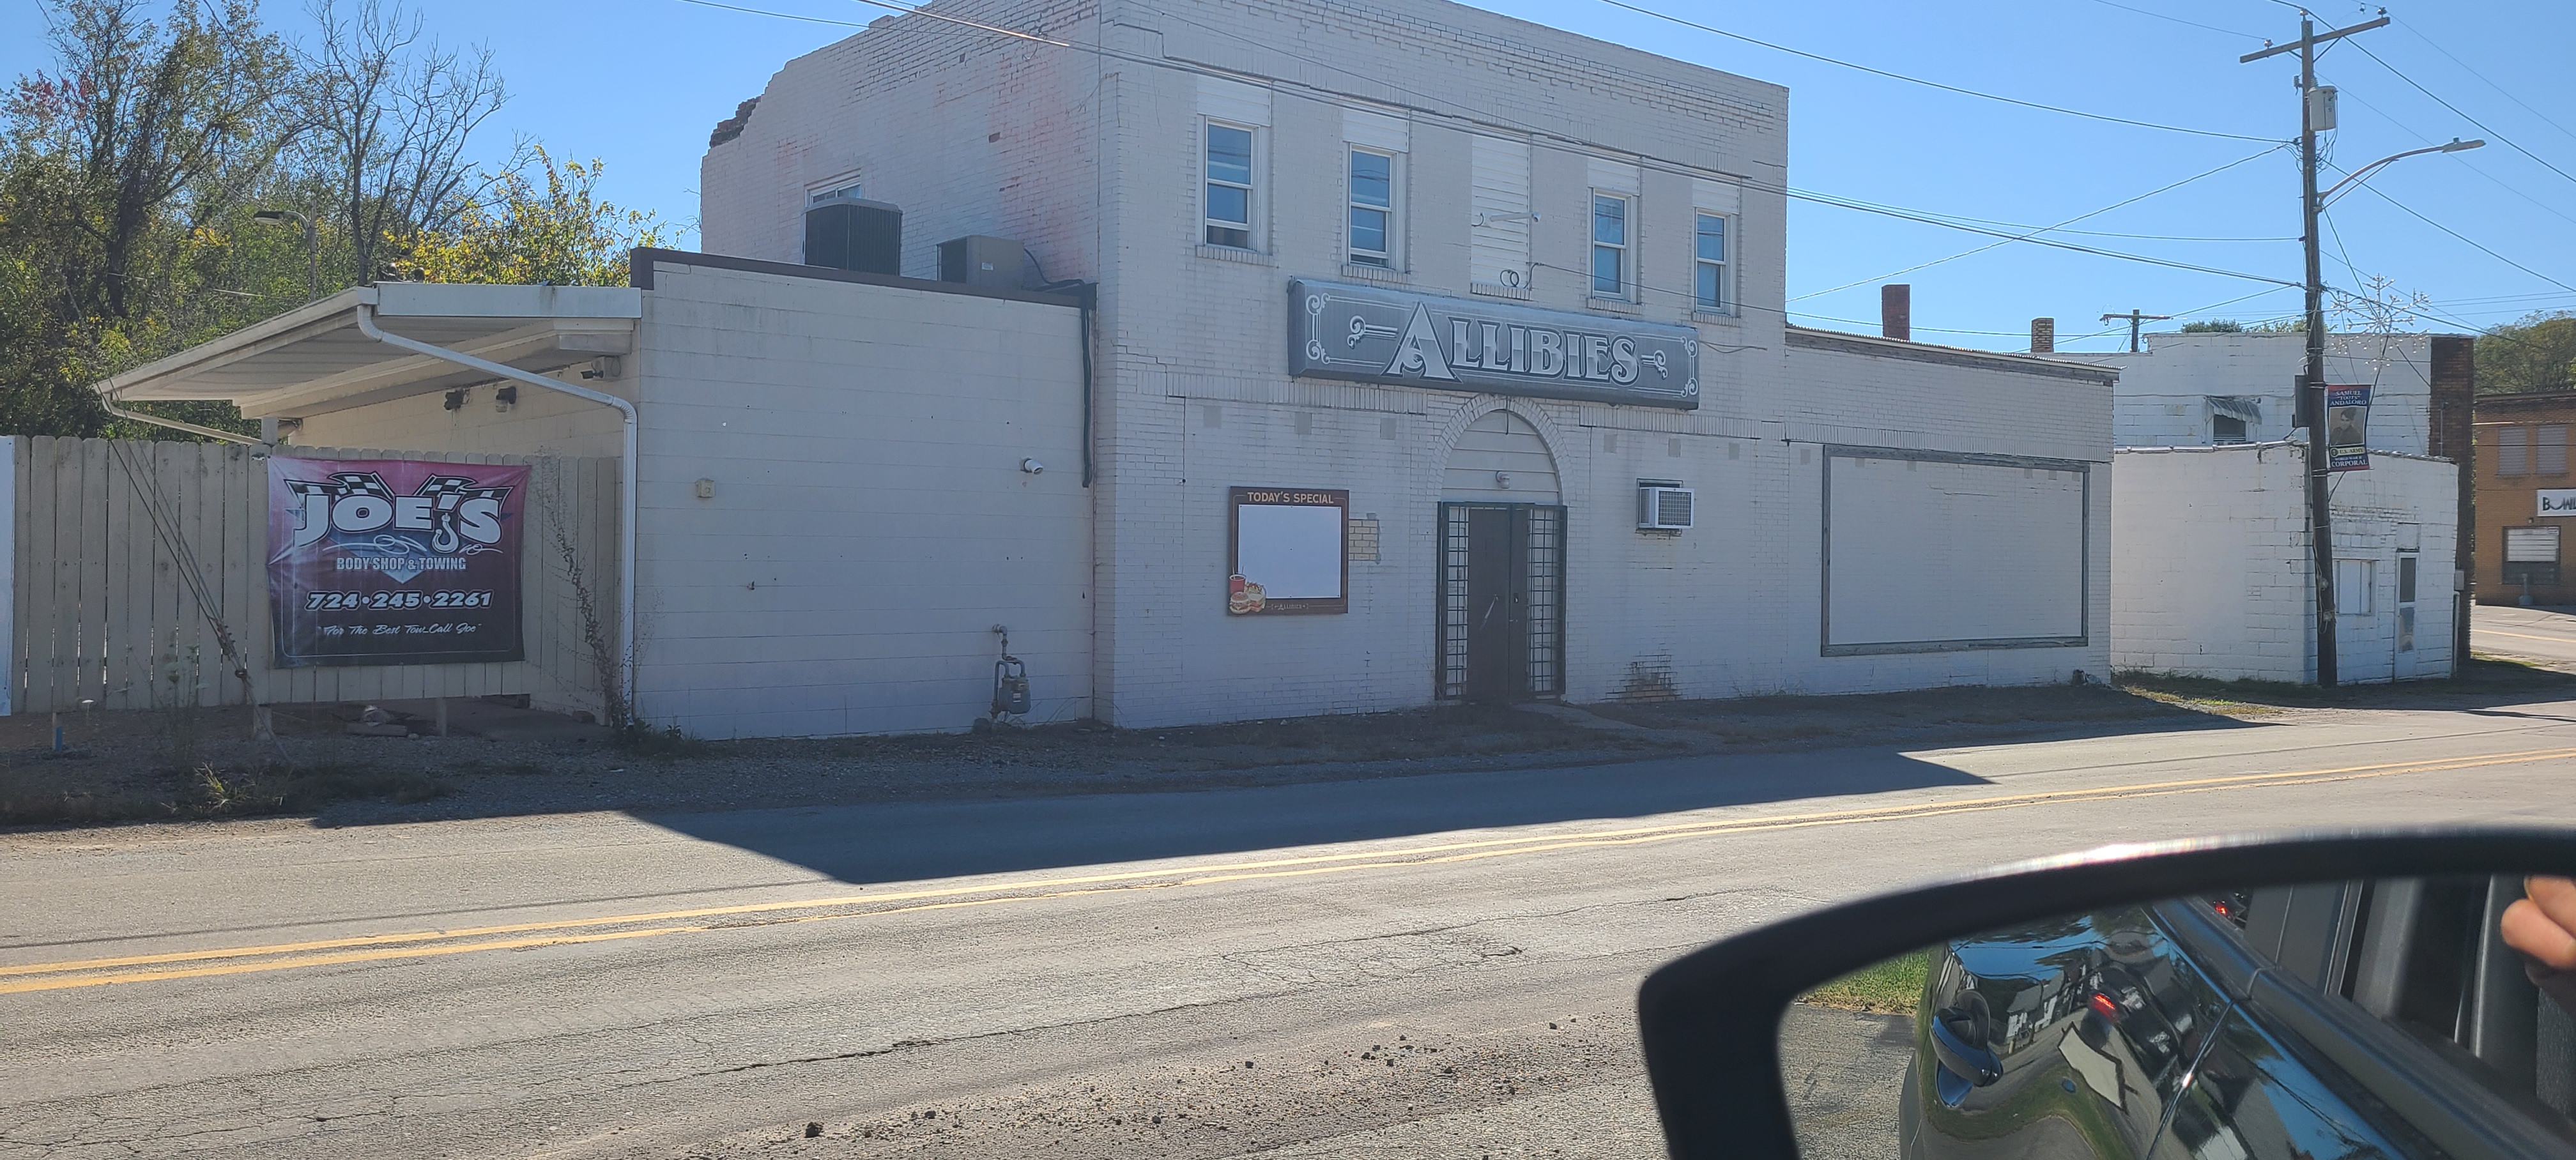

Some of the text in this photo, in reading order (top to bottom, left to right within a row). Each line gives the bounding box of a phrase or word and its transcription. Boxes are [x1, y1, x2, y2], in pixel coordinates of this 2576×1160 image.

[1381, 301, 1640, 383] ALLIBIES
[2331, 459, 2368, 468] CORPORAL
[1247, 491, 1335, 504] TODAY'S SPECIAL
[293, 492, 503, 548] JOE'S
[337, 557, 467, 570] BODY SHOP & TOWING
[348, 625, 368, 635] The
[372, 624, 401, 635] Best
